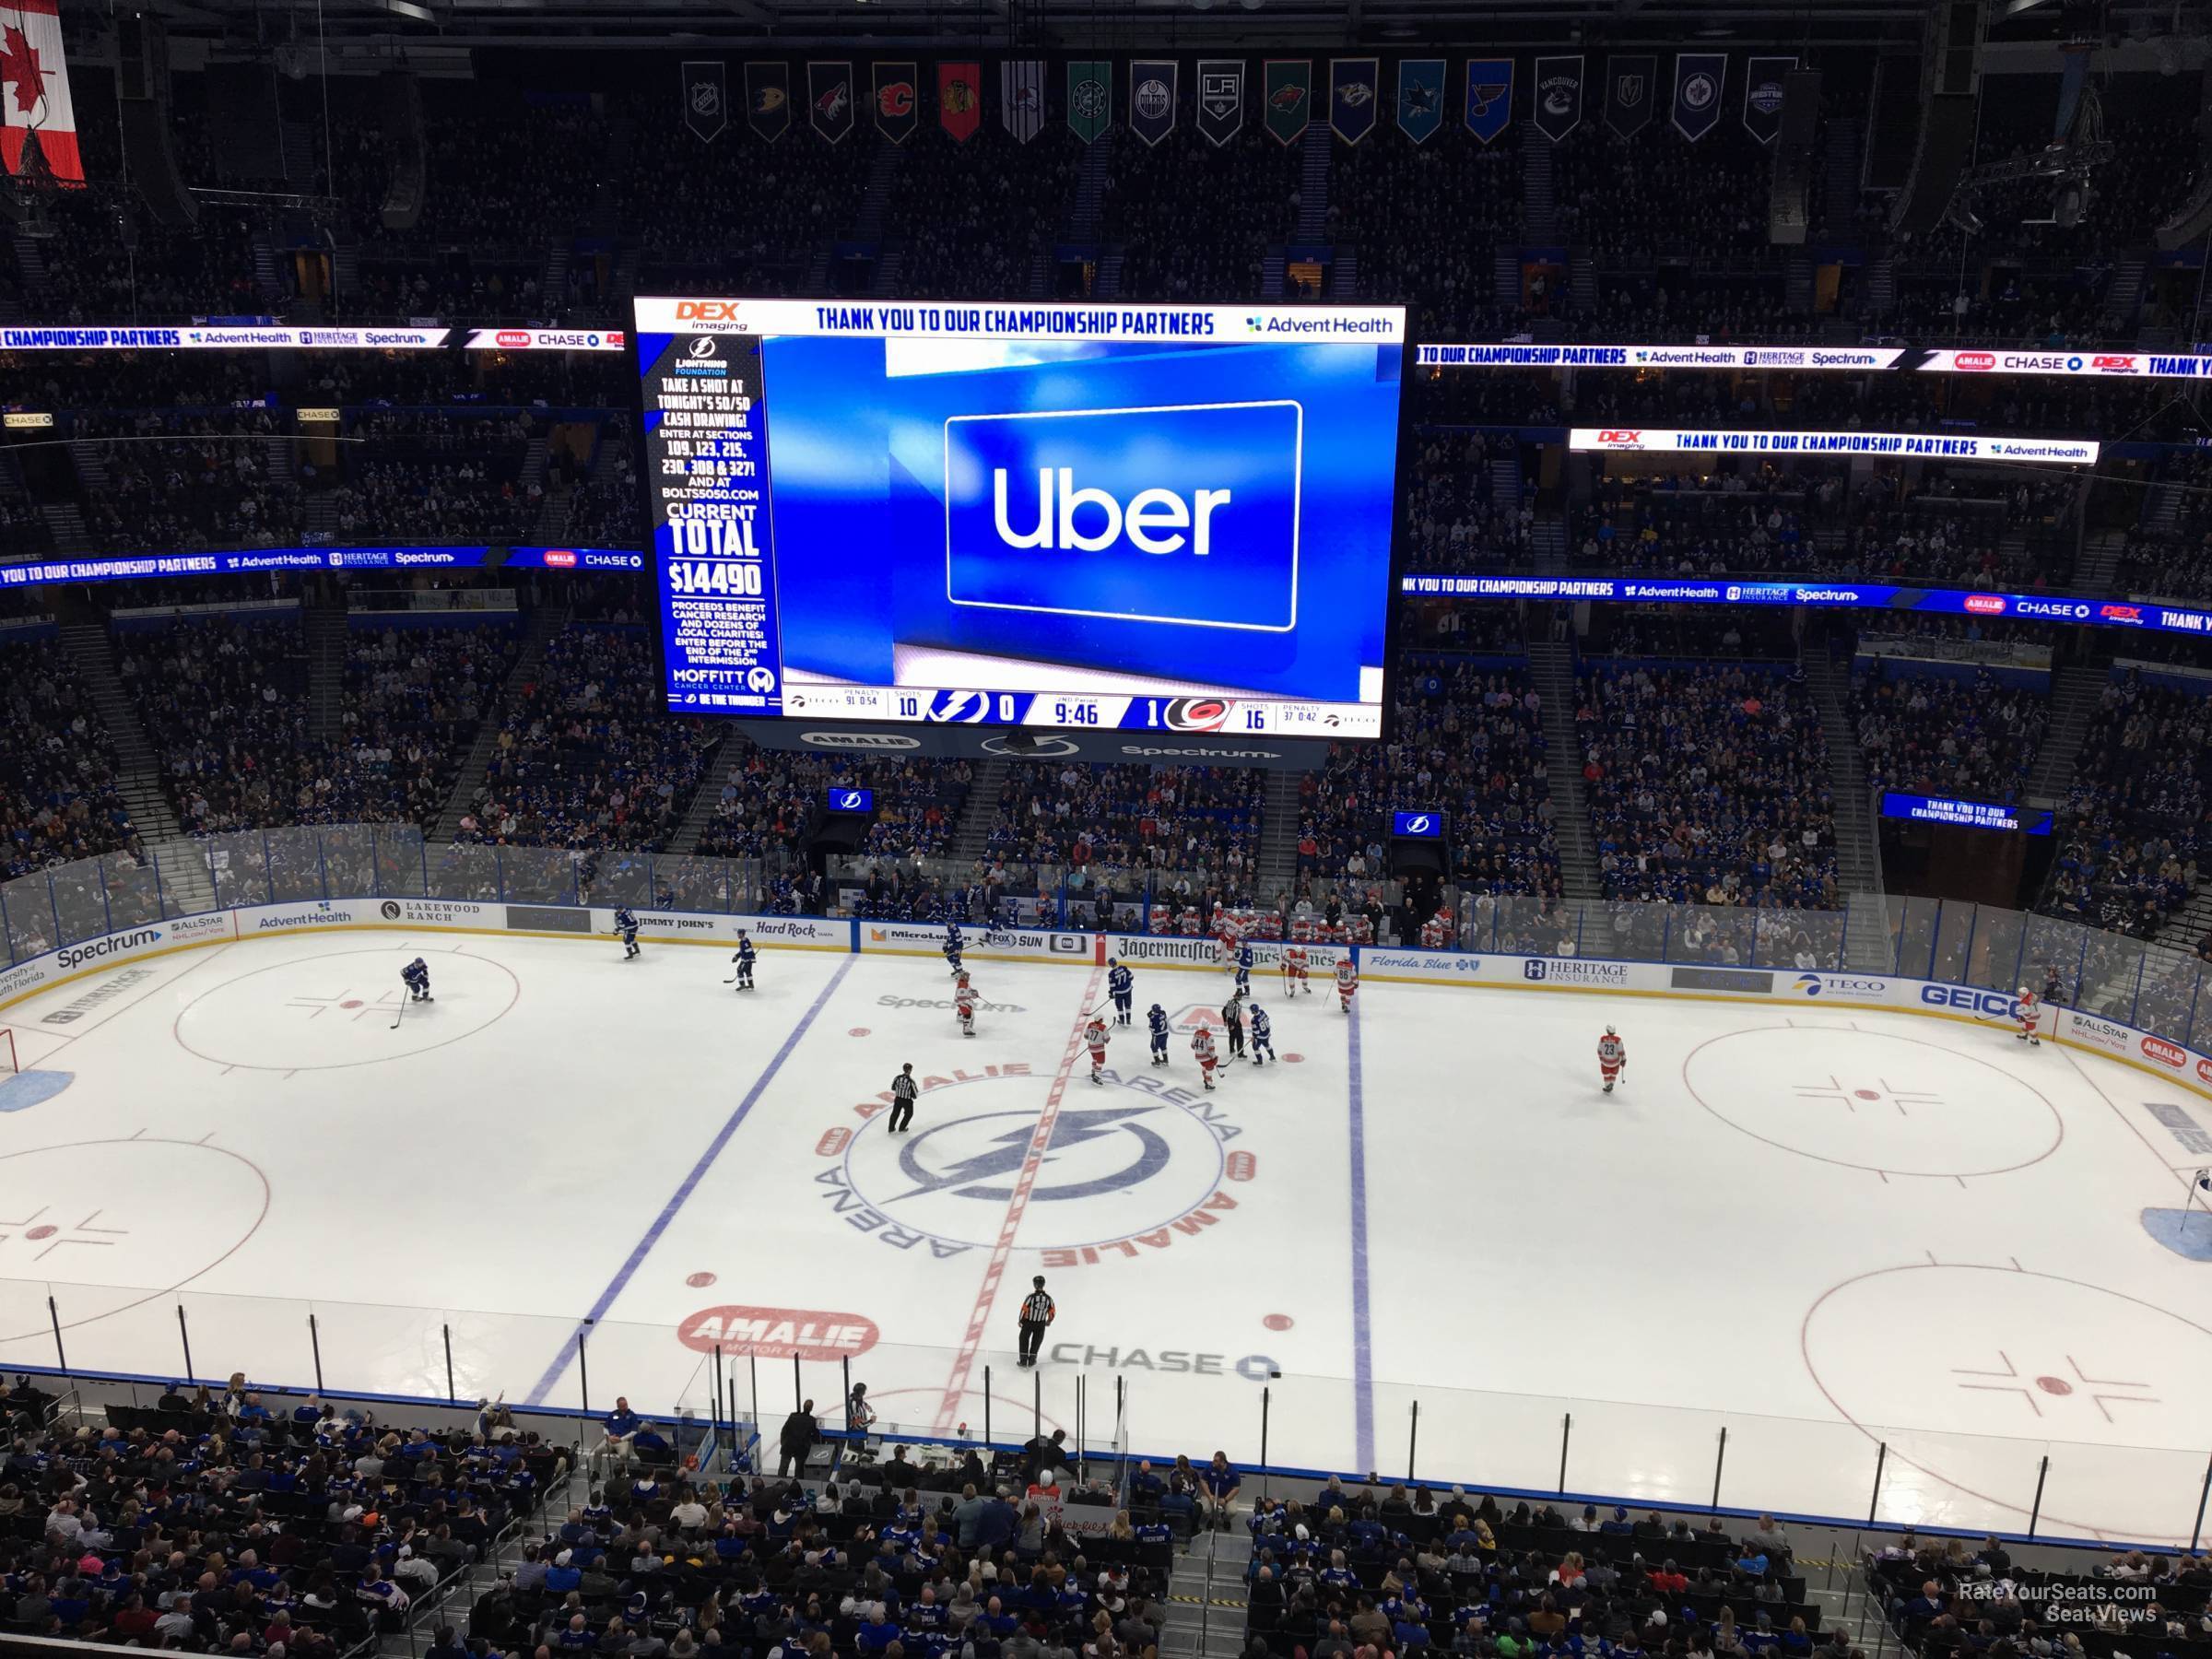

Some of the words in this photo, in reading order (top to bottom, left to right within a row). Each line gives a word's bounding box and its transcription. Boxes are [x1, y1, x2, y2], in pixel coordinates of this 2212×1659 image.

[1206, 76, 1236, 94] LA
[1539, 74, 1579, 90] VANCOUVER
[676, 301, 741, 321] DEX
[691, 320, 747, 331] imaging
[817, 308, 874, 330] THANK
[878, 308, 914, 331] YOU
[919, 309, 941, 331] TO
[945, 310, 980, 333] OUR
[984, 310, 1117, 335] CHAMPIONSHIP
[1122, 312, 1215, 335] PARTNERS
[1267, 317, 1393, 333] AdventHealth
[5, 330, 108, 347] CHAMPIONSHIP
[112, 330, 180, 346] PARTNERS
[365, 332, 422, 346] Spectrum
[538, 335, 584, 346] CHASE
[1423, 347, 1438, 362] TO
[1441, 347, 1465, 362] OUR
[1468, 347, 1560, 363] CHAMPIONSHIP
[1562, 348, 1627, 364] PARTNERS
[1812, 352, 1872, 367] Spectrum
[1958, 357, 1994, 365] AMALIE
[2092, 357, 2136, 368] DEX
[676, 359, 727, 369] LIGHTNING
[2005, 357, 2065, 369] CHASE
[2148, 358, 2200, 375] THANK
[676, 368, 726, 376] FOUNDATION
[662, 378, 688, 393] TAKE
[690, 378, 699, 393] A
[700, 379, 728, 394] SHOT
[731, 380, 744, 394] AT
[657, 394, 713, 410] TONIGHT'S
[715, 396, 750, 411] 50/50
[663, 412, 691, 427] CASH
[693, 412, 747, 428] DRAWING!
[659, 429, 691, 439] ENTER
[692, 429, 705, 439] AT
[706, 430, 753, 441] SECTIONS
[1598, 430, 1642, 442] DEX
[667, 441, 694, 458] 109,
[696, 441, 721, 458] 123,
[723, 441, 747, 459] 215,
[1677, 434, 1718, 449] THANK
[1723, 435, 1748, 450] YOU
[1753, 436, 1768, 450] TO
[1772, 436, 1799, 451] OUR
[1802, 436, 1901, 453] CHAMPIONSHIP
[1906, 439, 1978, 455] PARTNERS
[2004, 444, 2088, 458] AdventHealth
[662, 459, 689, 476] 230,
[691, 460, 715, 476] 308
[717, 460, 727, 476] &
[729, 461, 756, 477] 327!
[688, 477, 715, 488] AND
[716, 477, 732, 488] AT
[662, 488, 759, 500] BOLTS5050.COM
[666, 502, 757, 521] CURRENT
[994, 467, 1231, 555] Uber
[668, 518, 759, 556] TOTAL
[395, 553, 450, 565] Spectrum
[585, 555, 628, 566] CHASE
[1, 570, 26, 583] YOU
[28, 568, 43, 581] TO
[44, 566, 69, 580] OUR
[71, 559, 156, 577] CHAMPIONSHIP
[158, 557, 216, 573] PARTNERS
[668, 561, 761, 595] $14490
[672, 602, 724, 611] PROCEEDS
[725, 603, 766, 613] BENEFIT
[2017, 602, 2073, 616] CHASE
[673, 610, 712, 619] CANCER
[714, 612, 766, 621] RESEARCH
[2161, 611, 2204, 630] THANK
[704, 621, 744, 629] DOZENS
[745, 622, 759, 630] OF
[677, 629, 710, 638] LOCAL
[711, 629, 763, 639] CHARITIES!
[675, 638, 707, 646] ENTER
[709, 640, 747, 648] BEFORE
[747, 641, 767, 649] THE
[686, 647, 706, 655] END
[723, 648, 742, 656] THE
[744, 649, 758, 657] 2ND
[688, 656, 757, 665] INTERMISSION
[674, 669, 745, 684] MOFFITT
[700, 694, 711, 704] BE
[712, 694, 726, 705] THE
[728, 695, 766, 707] THUNDER
[846, 696, 855, 705] 91
[900, 698, 917, 716] 10
[999, 694, 1015, 722] 0
[1055, 703, 1099, 724] 9:46
[1147, 700, 1159, 726] 1
[1246, 711, 1265, 730] 16
[1284, 712, 1293, 722] 37
[1299, 712, 1316, 722] 0:42
[812, 735, 913, 747] AMALIE
[1122, 746, 1270, 759] Spectrum
[1912, 807, 1973, 825] CHAMPIONSHIP
[1974, 815, 2018, 830] PARTNERS
[406, 901, 480, 914] LAKEWOOD
[259, 912, 351, 929] AdventHealth
[406, 911, 453, 922] RANCH
[639, 918, 675, 927] JIMMY
[677, 919, 714, 929] JOHN'S
[756, 922, 786, 935] Hard
[787, 923, 817, 938] Rock
[993, 934, 1011, 943] FOX
[1018, 935, 1042, 947] SUN
[57, 929, 155, 969] Spectrum
[1370, 956, 1420, 968] Florida
[1423, 959, 1452, 970] Blue
[1550, 961, 1628, 976] HERITAGE
[14, 971, 44, 990] Florida
[1114, 971, 1127, 985] 77
[1549, 973, 1627, 985] INSURANCE
[1825, 978, 1886, 992] TECO
[1194, 1039, 1204, 1051] 44
[1605, 1043, 1615, 1055] 23
[2144, 1041, 2184, 1065] AMALIE
[815, 1165, 973, 1259] ARENA
[1041, 1191, 1239, 1267] AMALIE
[689, 1316, 868, 1348] AMALIE
[724, 1343, 782, 1356] MOTOR
[786, 1347, 813, 1358] OIL
[1051, 1343, 1225, 1376] CHASE
